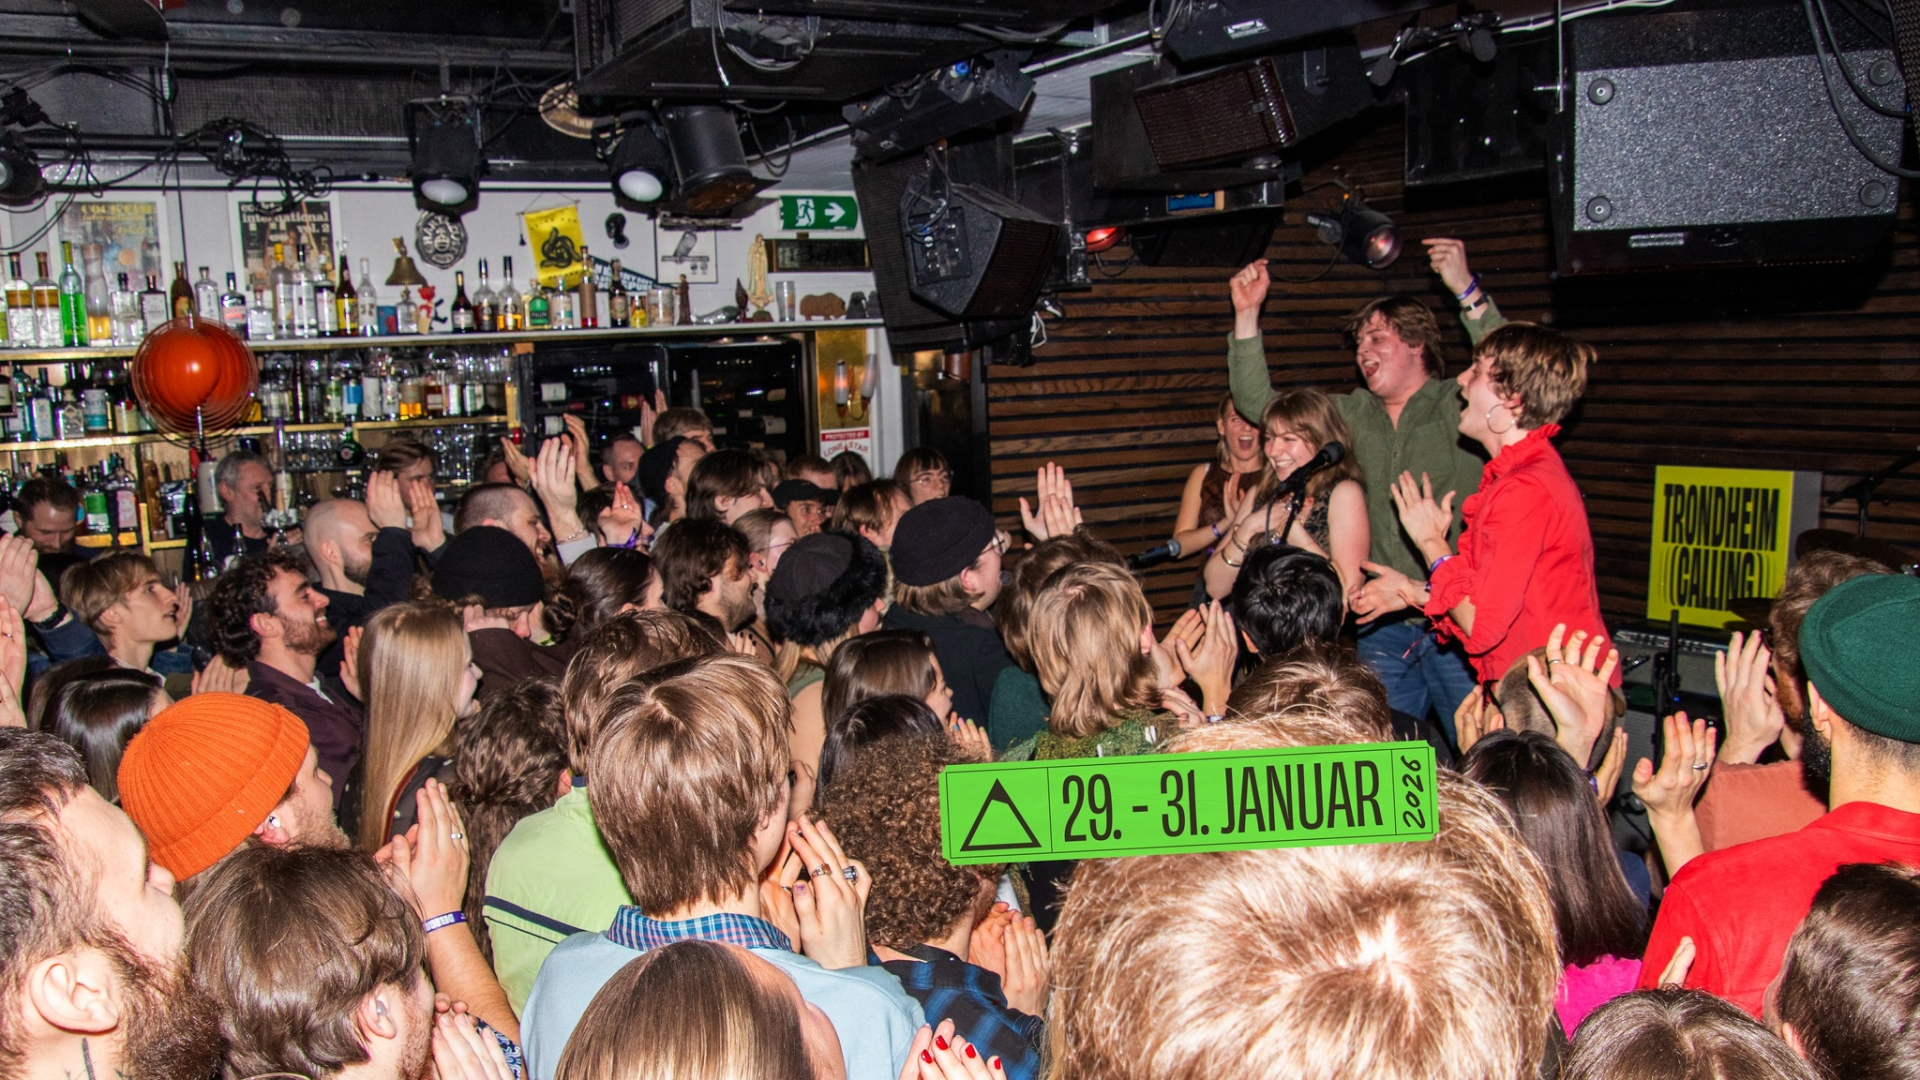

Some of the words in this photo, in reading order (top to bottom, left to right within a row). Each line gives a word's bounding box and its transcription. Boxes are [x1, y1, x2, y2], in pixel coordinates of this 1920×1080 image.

[823, 442, 843, 457] LONE
[849, 441, 869, 453] STAR
[1662, 483, 1780, 552] TRONDHEIM
